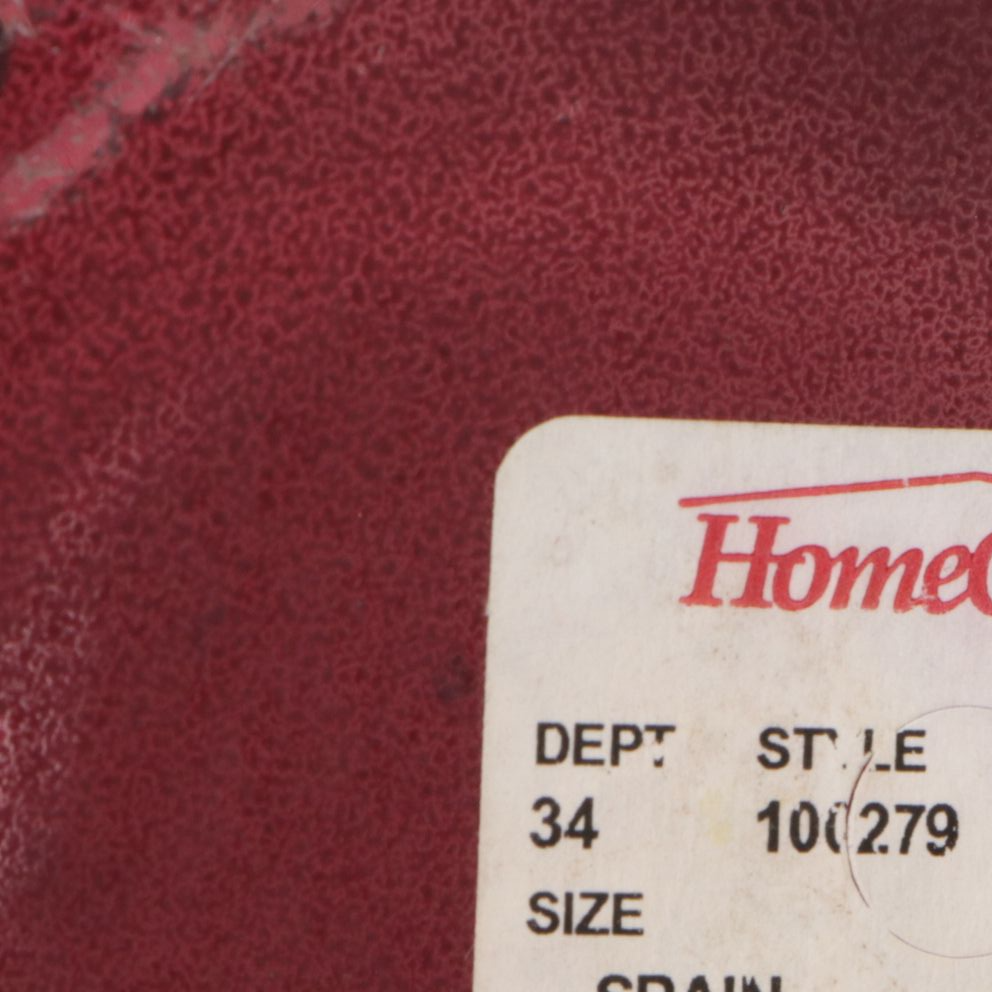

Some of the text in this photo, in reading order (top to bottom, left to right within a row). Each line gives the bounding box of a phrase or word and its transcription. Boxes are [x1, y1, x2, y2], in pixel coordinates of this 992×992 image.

[537, 723, 677, 768] DEPT
[530, 797, 600, 850] 34
[527, 892, 645, 937] SIZE
